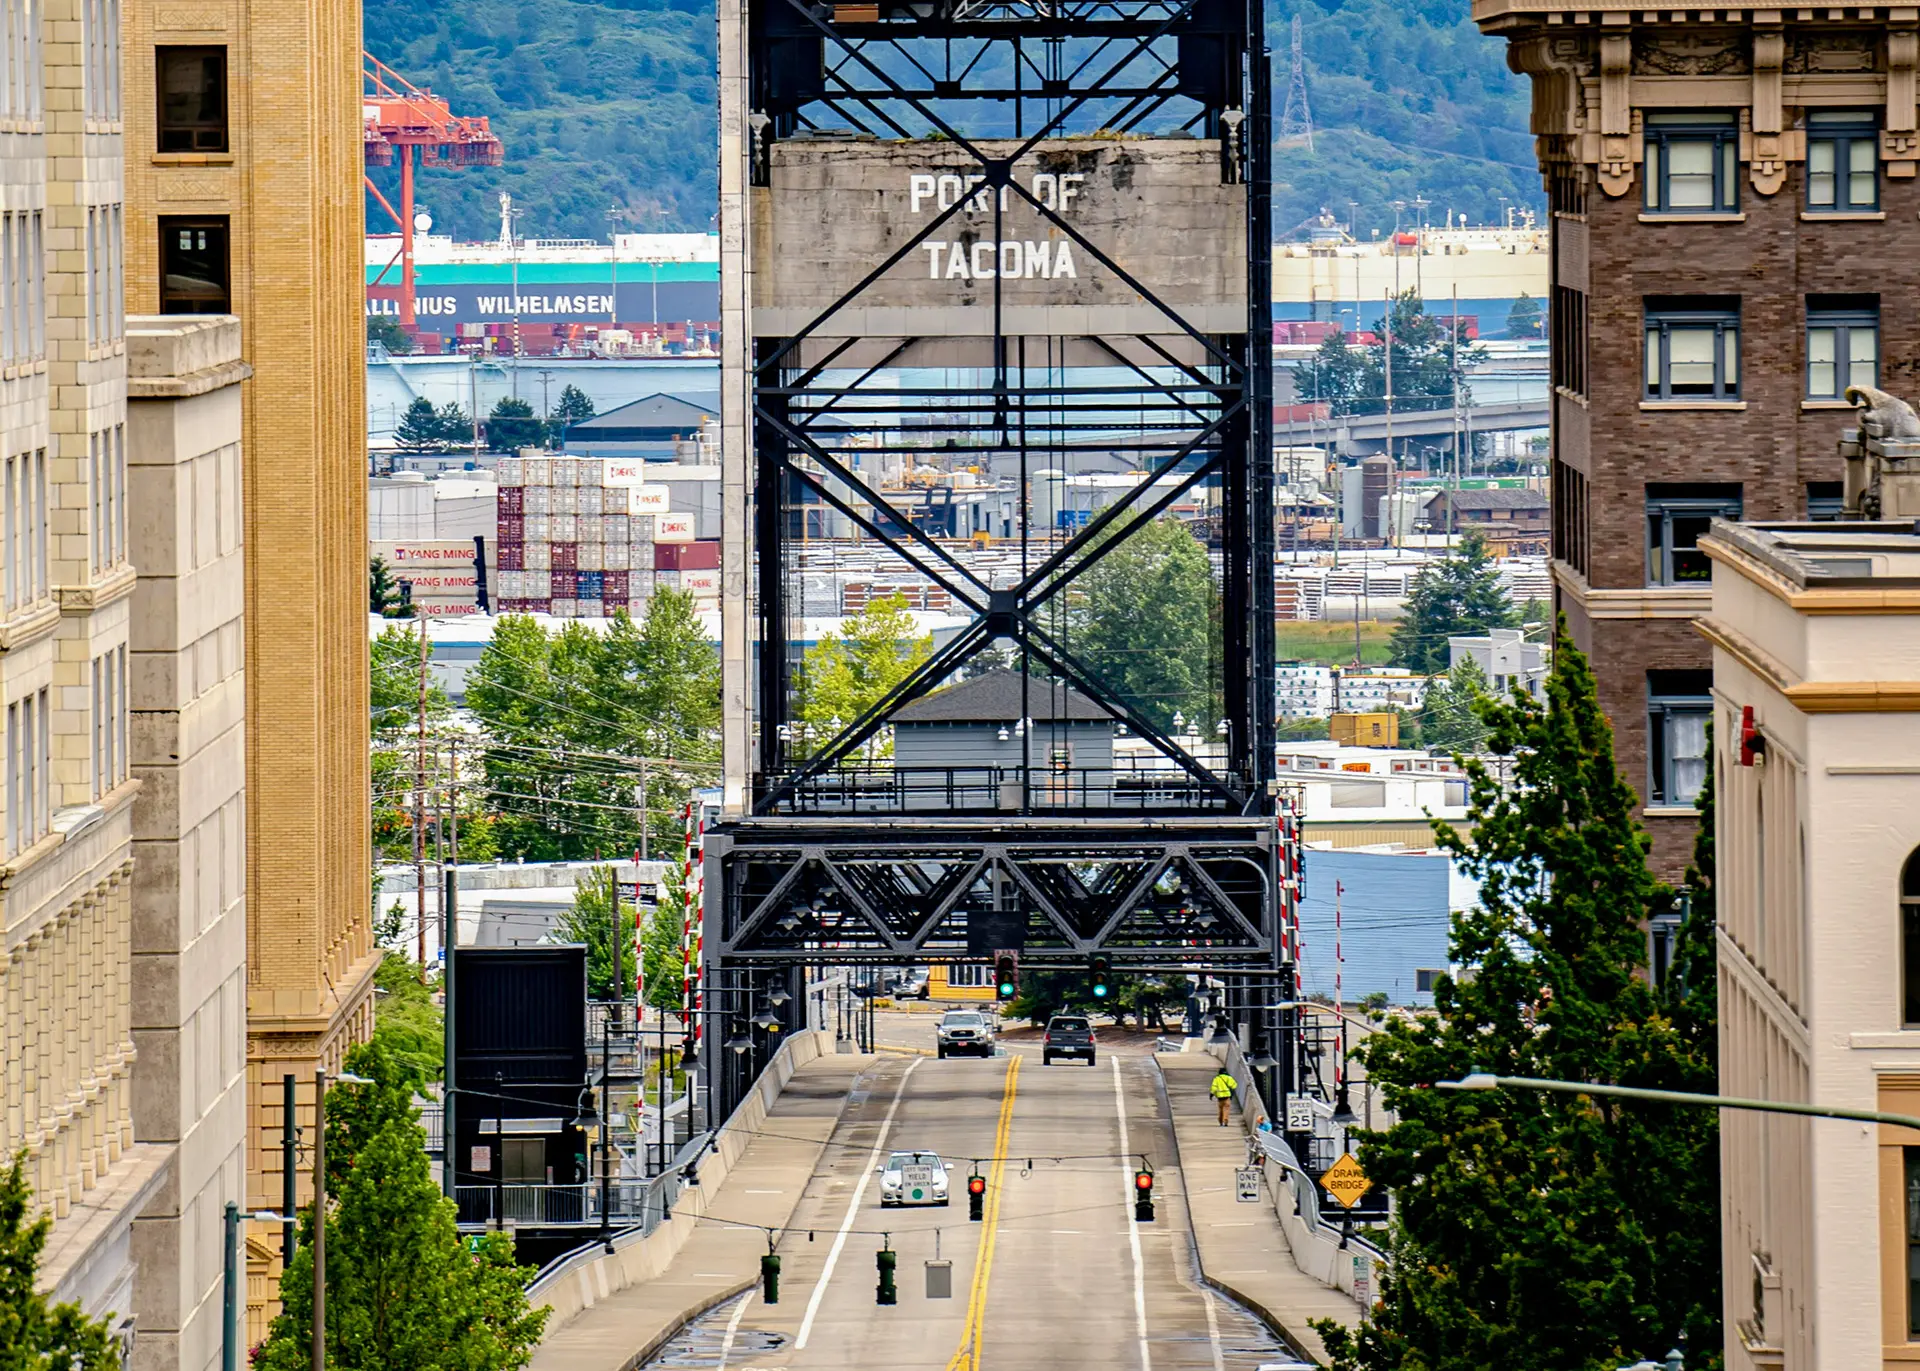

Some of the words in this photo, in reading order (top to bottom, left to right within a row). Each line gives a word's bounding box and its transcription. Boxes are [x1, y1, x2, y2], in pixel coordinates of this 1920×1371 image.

[1032, 174, 1085, 212] OF
[922, 240, 1077, 279] TACOMA
[365, 296, 457, 316] LLNIUS
[477, 295, 613, 314] WILHELMSEN
[408, 549, 440, 559] YANG
[443, 549, 475, 559] MING
[444, 577, 475, 587] MING
[425, 605, 441, 615] NG
[445, 605, 475, 615] MING
[1290, 1115, 1310, 1127] 25
[1239, 1173, 1257, 1181] ONE
[1330, 1180, 1364, 1190] BRIDGE
